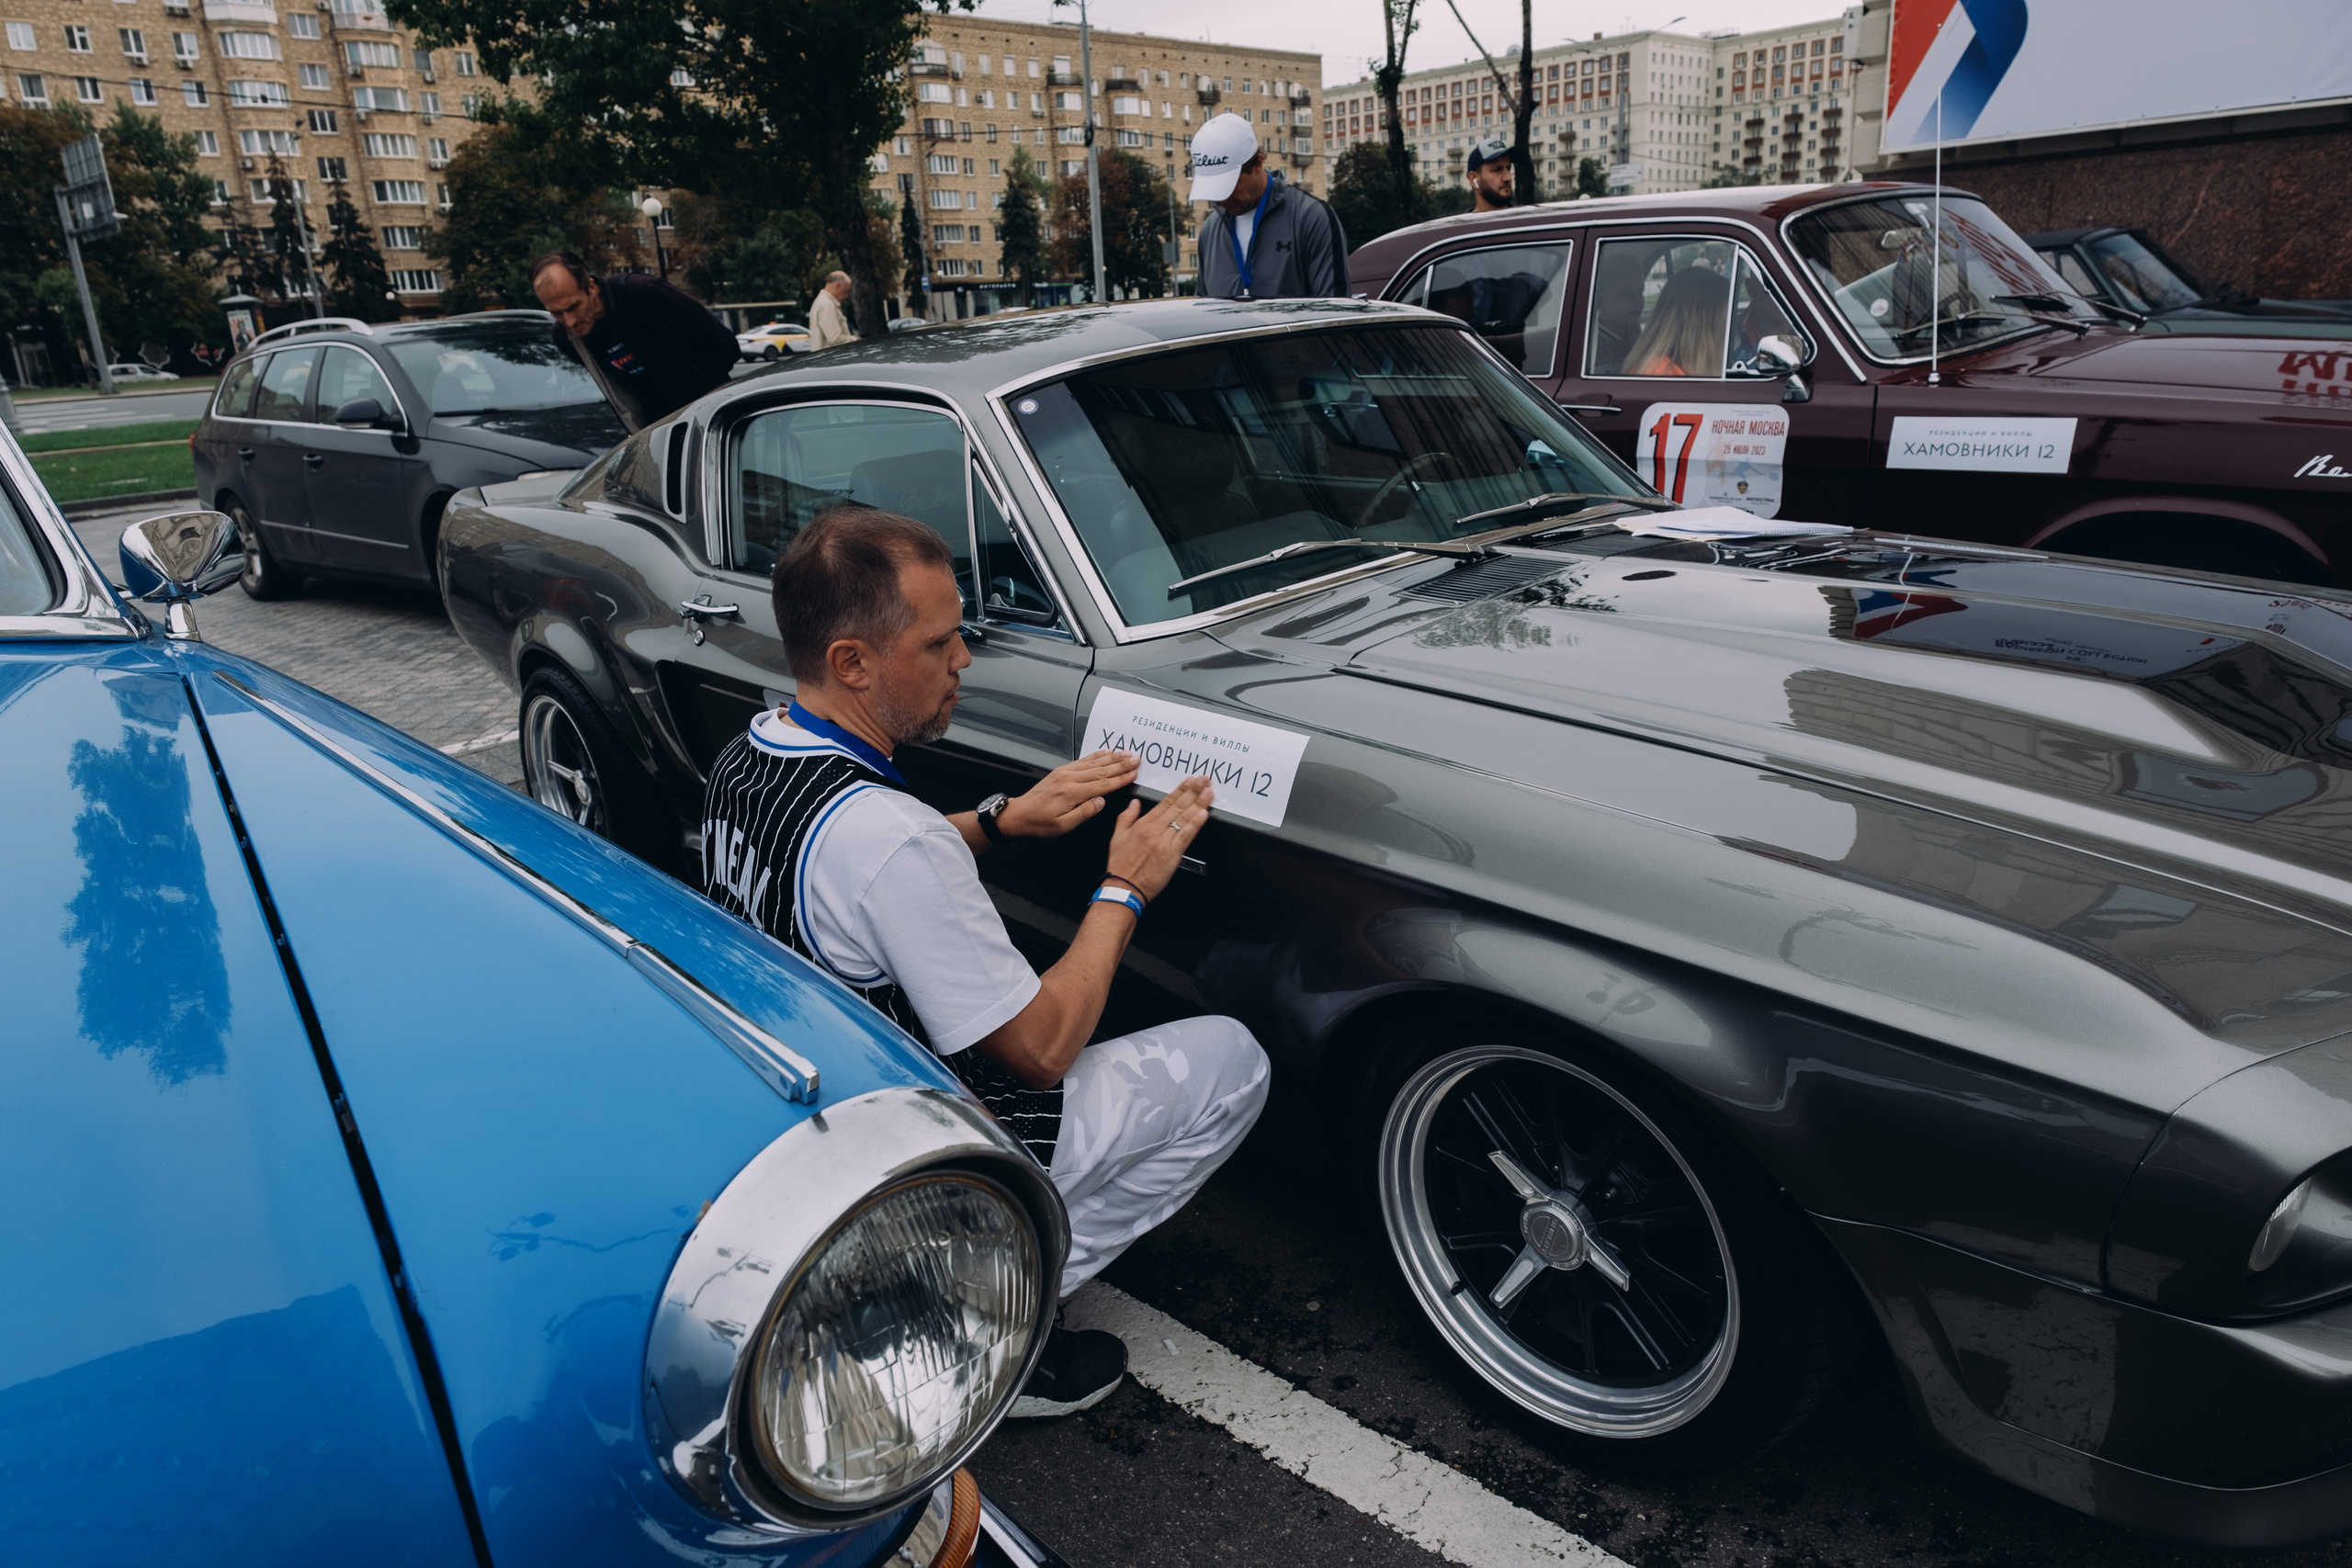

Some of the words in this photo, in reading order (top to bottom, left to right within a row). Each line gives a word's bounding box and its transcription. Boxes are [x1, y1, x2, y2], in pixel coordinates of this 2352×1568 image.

[1712, 420, 1746, 434] НОЧНАЯ
[1748, 421, 1785, 436] МОСКВА
[1649, 412, 1703, 504] 17
[1724, 445, 1731, 455] 29
[1733, 445, 1749, 455] ИЮЛЯ
[1750, 446, 1766, 456] 2023
[1903, 442, 2030, 458] ХАМОВНИКИ
[2037, 444, 2055, 458] 12
[1132, 716, 1197, 739] РЕЗИДЕНЦИИ
[1202, 733, 1209, 742] И
[1213, 736, 1250, 753] ВИЛЛЫ
[1099, 728, 1243, 788] ХАМОВНИКИ
[1250, 771, 1273, 797] 12
